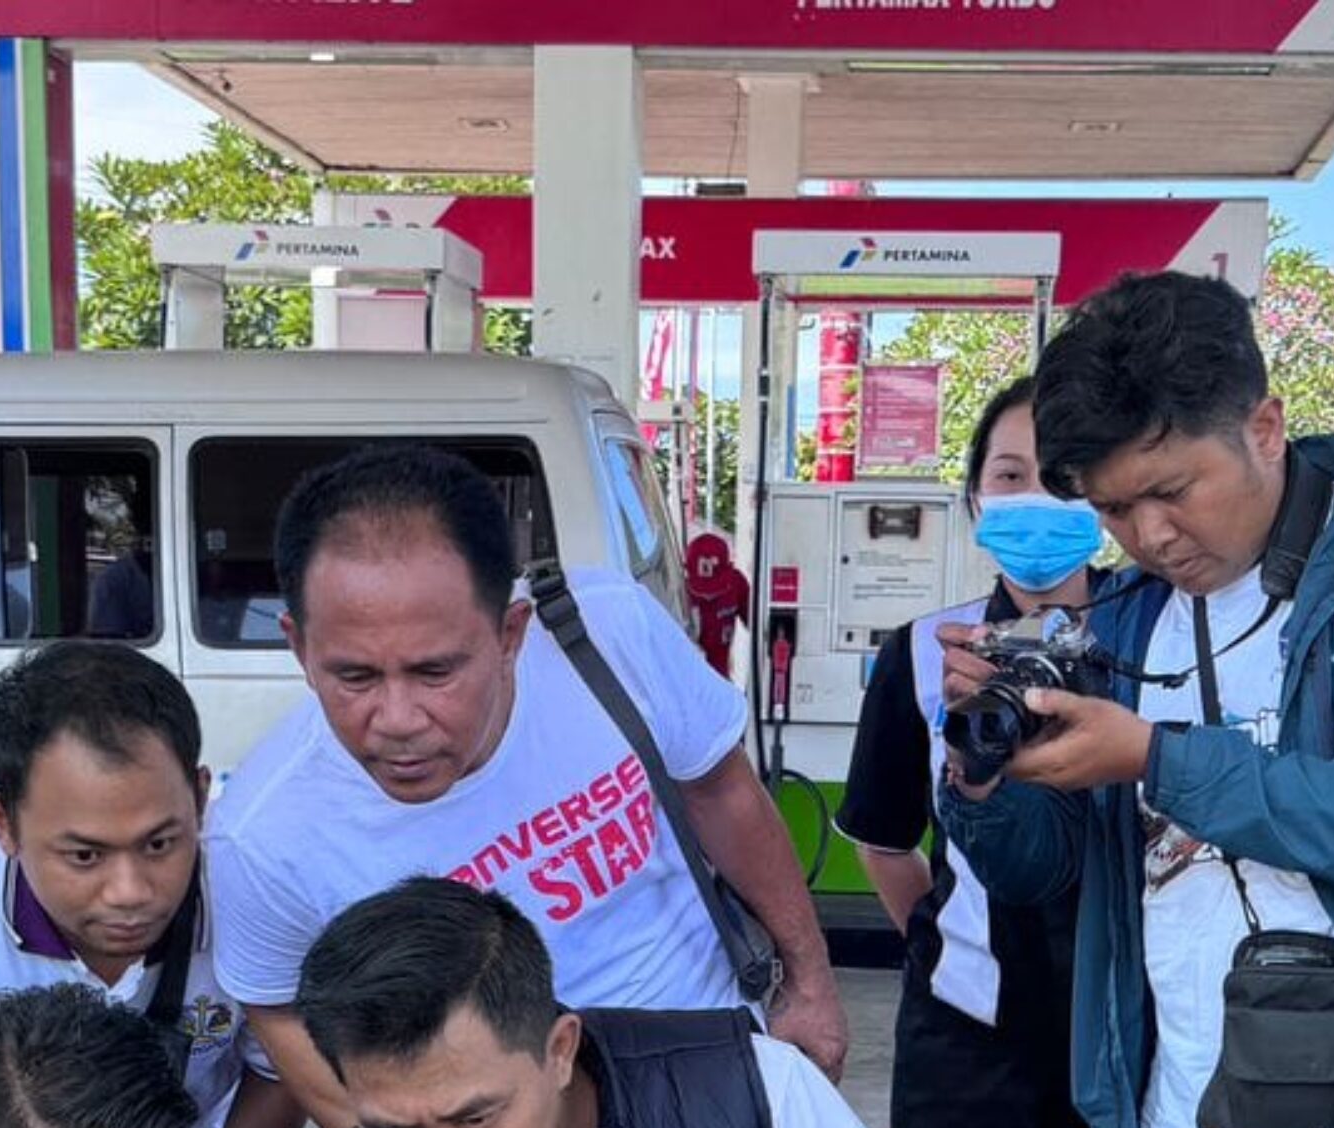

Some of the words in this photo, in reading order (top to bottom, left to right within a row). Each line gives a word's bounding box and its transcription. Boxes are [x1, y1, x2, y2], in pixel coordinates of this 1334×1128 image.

[276, 242, 359, 256] PERTAMINA
[640, 237, 676, 259] AX
[884, 249, 971, 261] PERTAMINA
[528, 790, 655, 921] STAR
